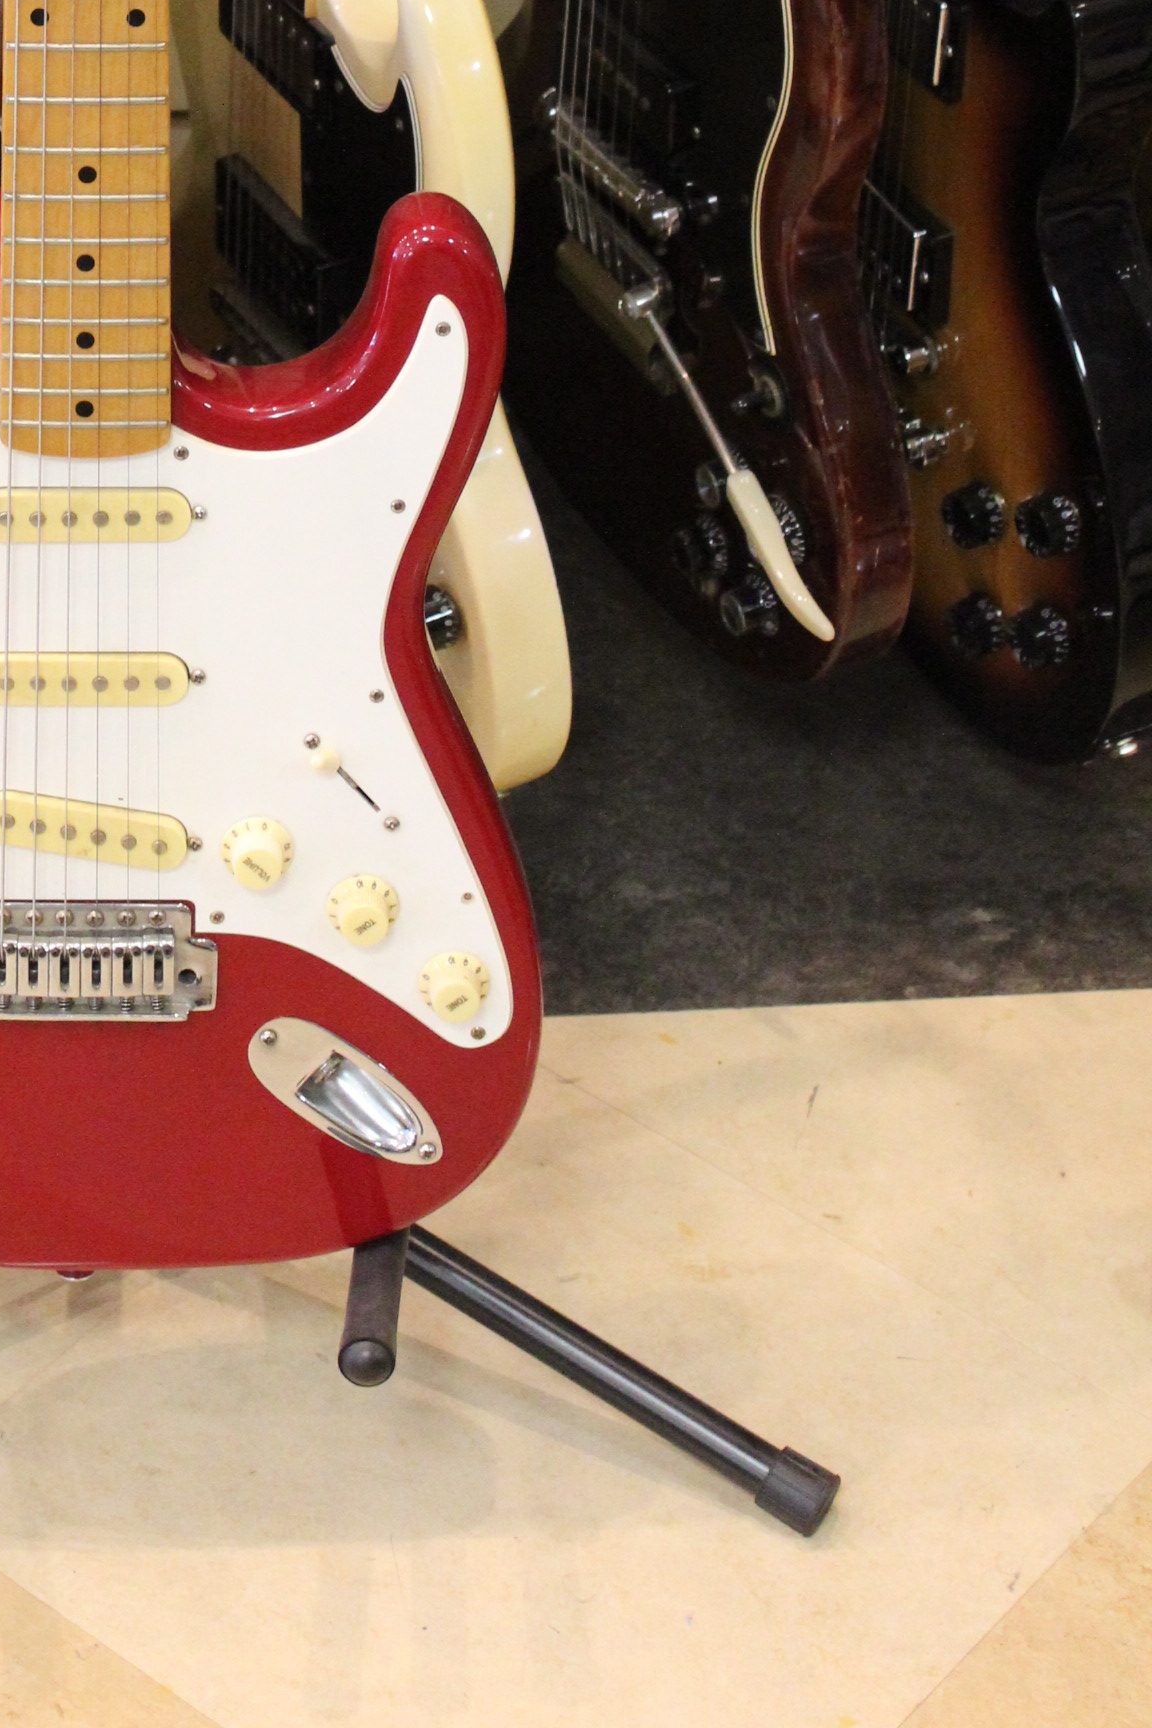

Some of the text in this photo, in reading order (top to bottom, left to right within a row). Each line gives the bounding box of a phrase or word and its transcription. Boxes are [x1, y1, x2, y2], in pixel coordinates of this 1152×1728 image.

[242, 856, 272, 882] VOLUME
[353, 918, 377, 936] TONE
[445, 994, 469, 1012] TONE
